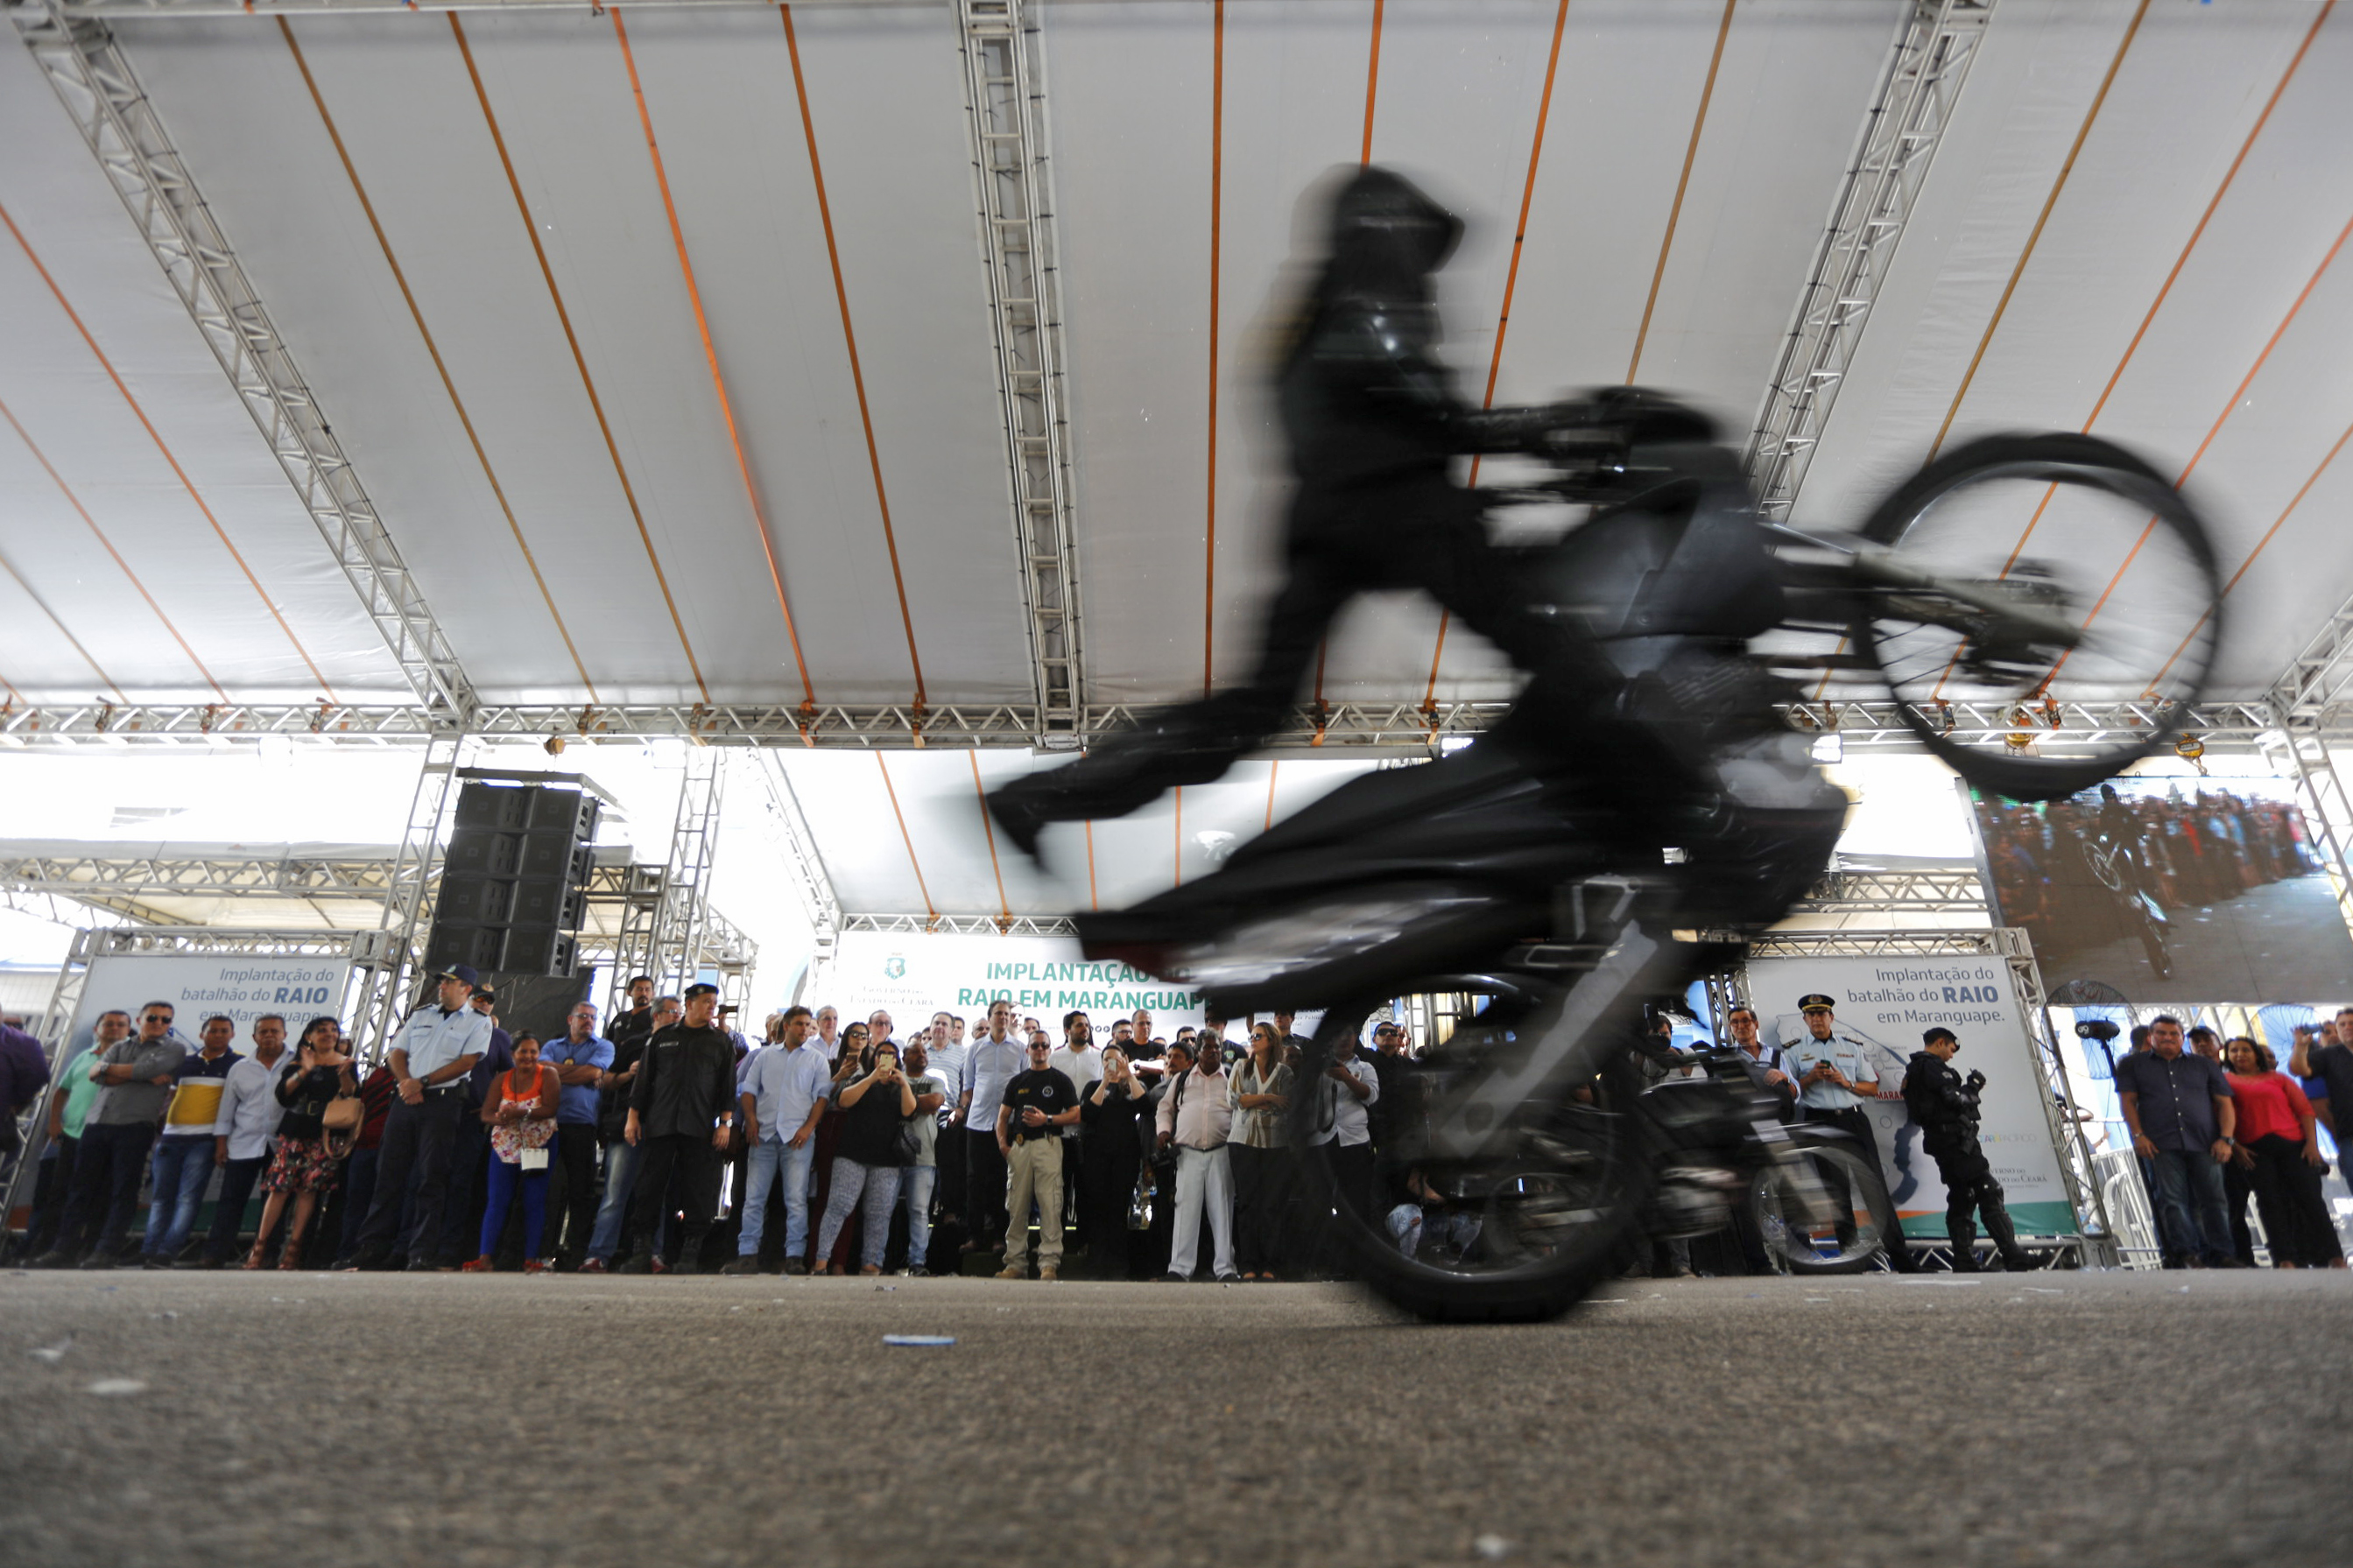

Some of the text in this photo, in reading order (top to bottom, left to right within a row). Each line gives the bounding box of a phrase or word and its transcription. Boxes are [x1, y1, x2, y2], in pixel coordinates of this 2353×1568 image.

[220, 968, 335, 985] Implantação do
[1876, 966, 1994, 985] Implantação do
[180, 987, 328, 1004] batalhão do RAIO
[958, 988, 1012, 1006] RAIO
[1019, 990, 1051, 1008] EM
[1847, 986, 1998, 1003] batalhão do RAIO
[1877, 1009, 2004, 1026] em Maranguape.
